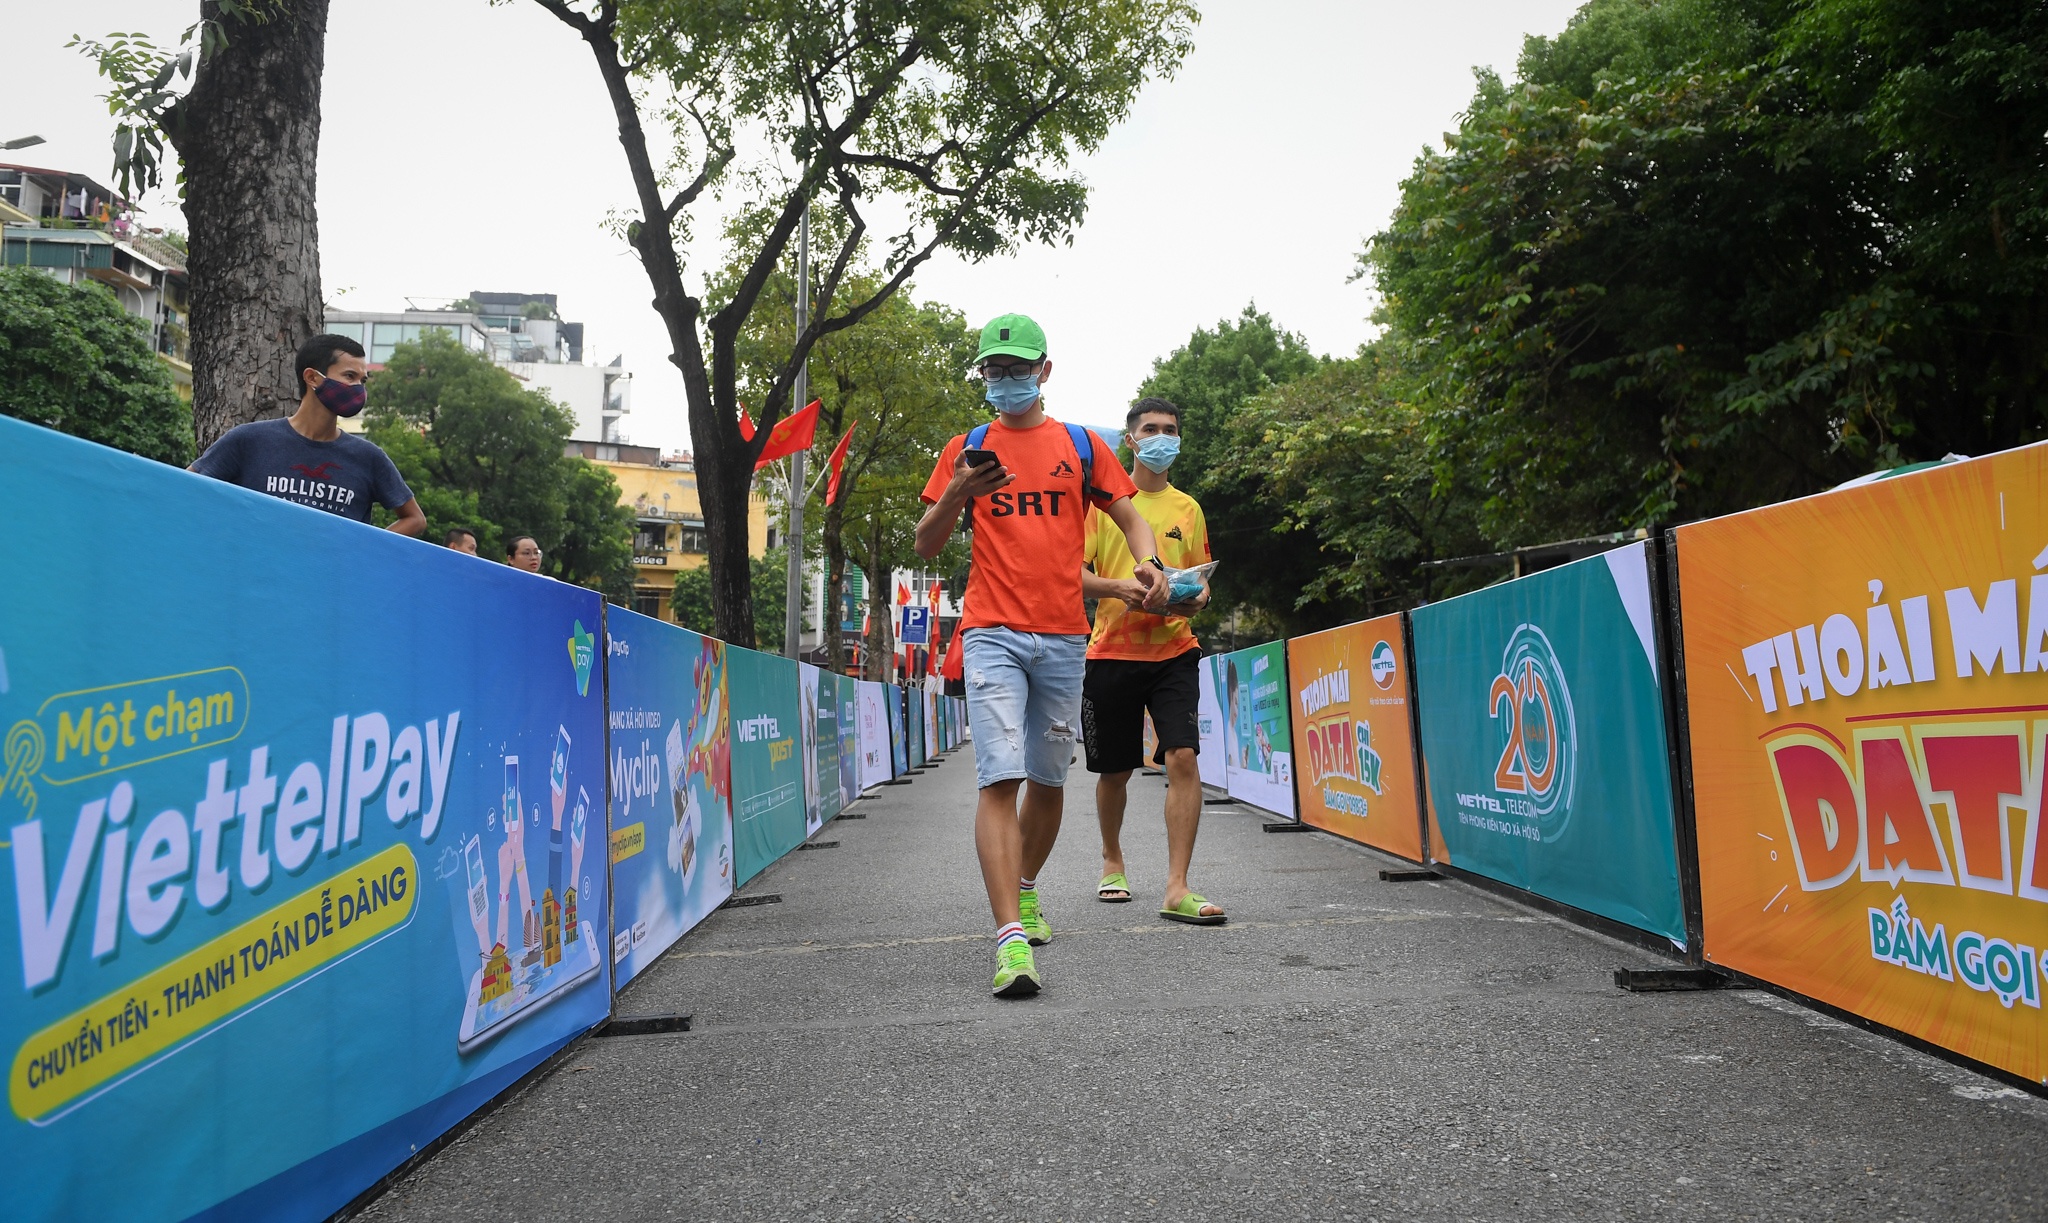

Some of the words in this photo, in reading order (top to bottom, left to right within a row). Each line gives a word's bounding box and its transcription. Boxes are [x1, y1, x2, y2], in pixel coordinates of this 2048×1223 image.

[266, 475, 355, 506] HOLLISTER
[991, 490, 1067, 518] SRT
[908, 609, 922, 625] P
[577, 653, 590, 670] pay
[1742, 578, 1936, 714] THOẢI
[1372, 661, 1395, 670] VIETTEL
[1329, 659, 1350, 704] MÁI
[56, 699, 137, 767] Một
[144, 689, 234, 744] chạm
[625, 707, 634, 729] XÃ
[635, 707, 644, 733] HỘI
[645, 711, 660, 729] VIDEO
[737, 713, 781, 743] VIETTEL
[1356, 720, 1371, 747] CHỈ
[1489, 661, 1558, 796] 20
[1305, 717, 1357, 786] DATA
[1357, 746, 1382, 795] 15K
[1456, 792, 1506, 814] VIETTEL
[1505, 798, 1539, 820] TELECOM
[1469, 815, 1486, 830] PHONG
[1499, 821, 1512, 837] TẠO
[1522, 824, 1532, 842] HỘI
[10, 710, 461, 993] ViettelPay
[1868, 894, 1954, 983] BẤM
[1953, 930, 2041, 1009] GỌI
[26, 1018, 103, 1090] CHUYỂN
[106, 997, 149, 1048] TIỀN
[163, 962, 237, 1019] THANH
[238, 921, 301, 979] TOÁN
[303, 888, 334, 948] DỄ
[338, 865, 408, 931] DÀNG
